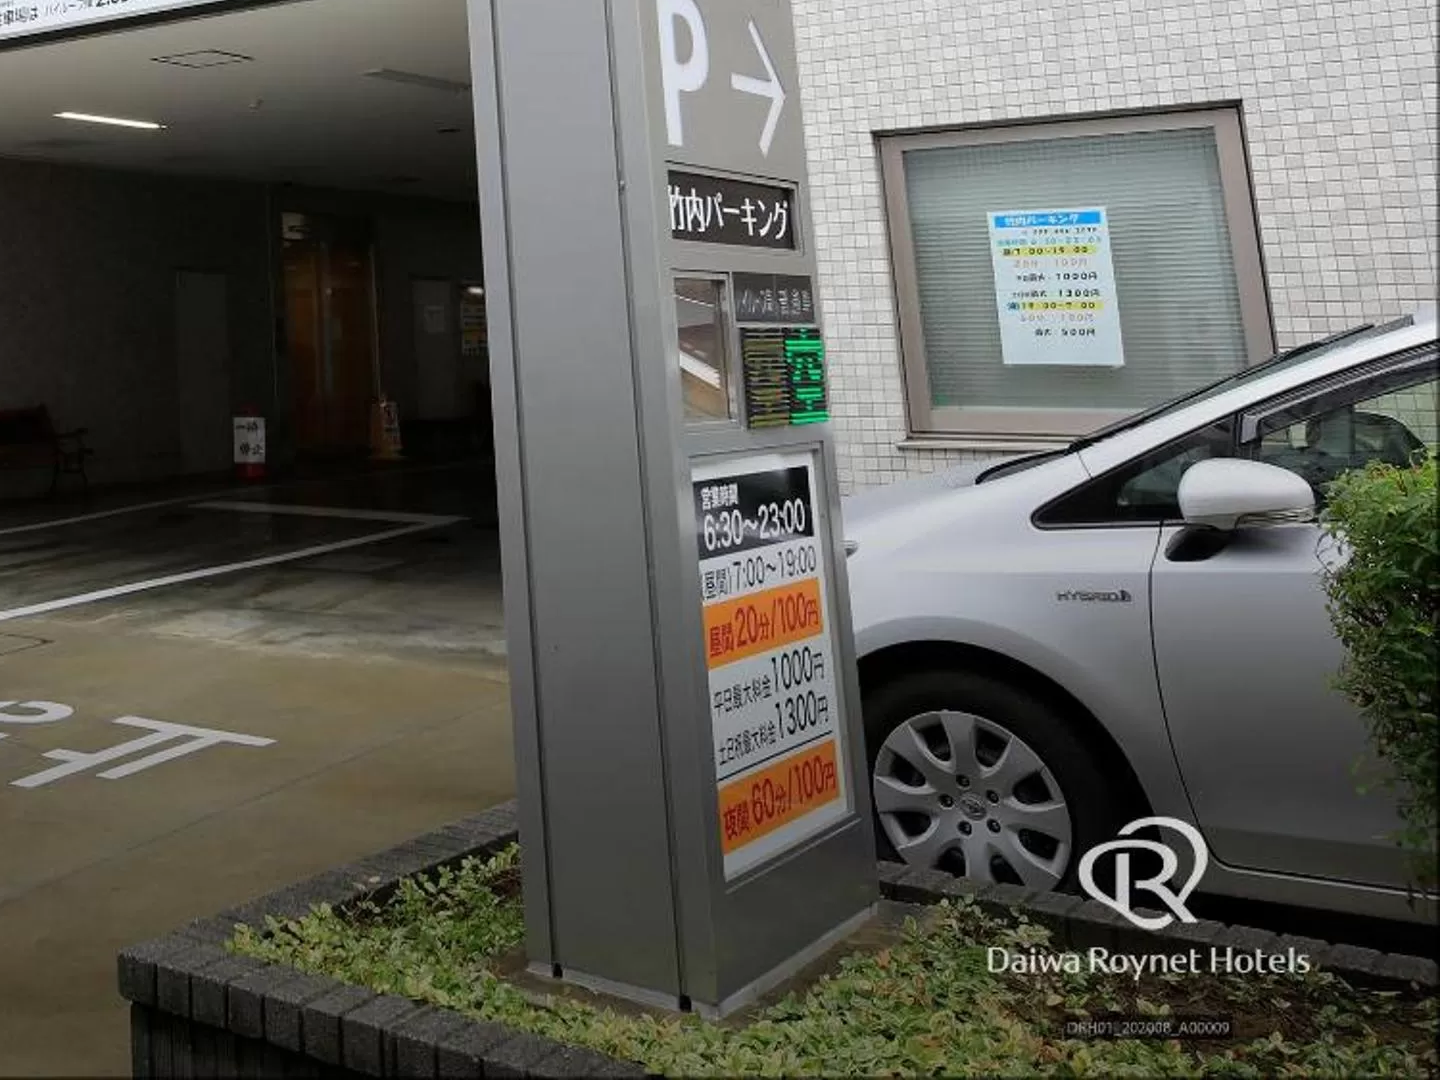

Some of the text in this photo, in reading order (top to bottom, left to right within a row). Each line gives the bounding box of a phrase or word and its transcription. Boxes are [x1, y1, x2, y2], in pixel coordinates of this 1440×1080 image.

[667, 184, 788, 240] 竹内パーキング
